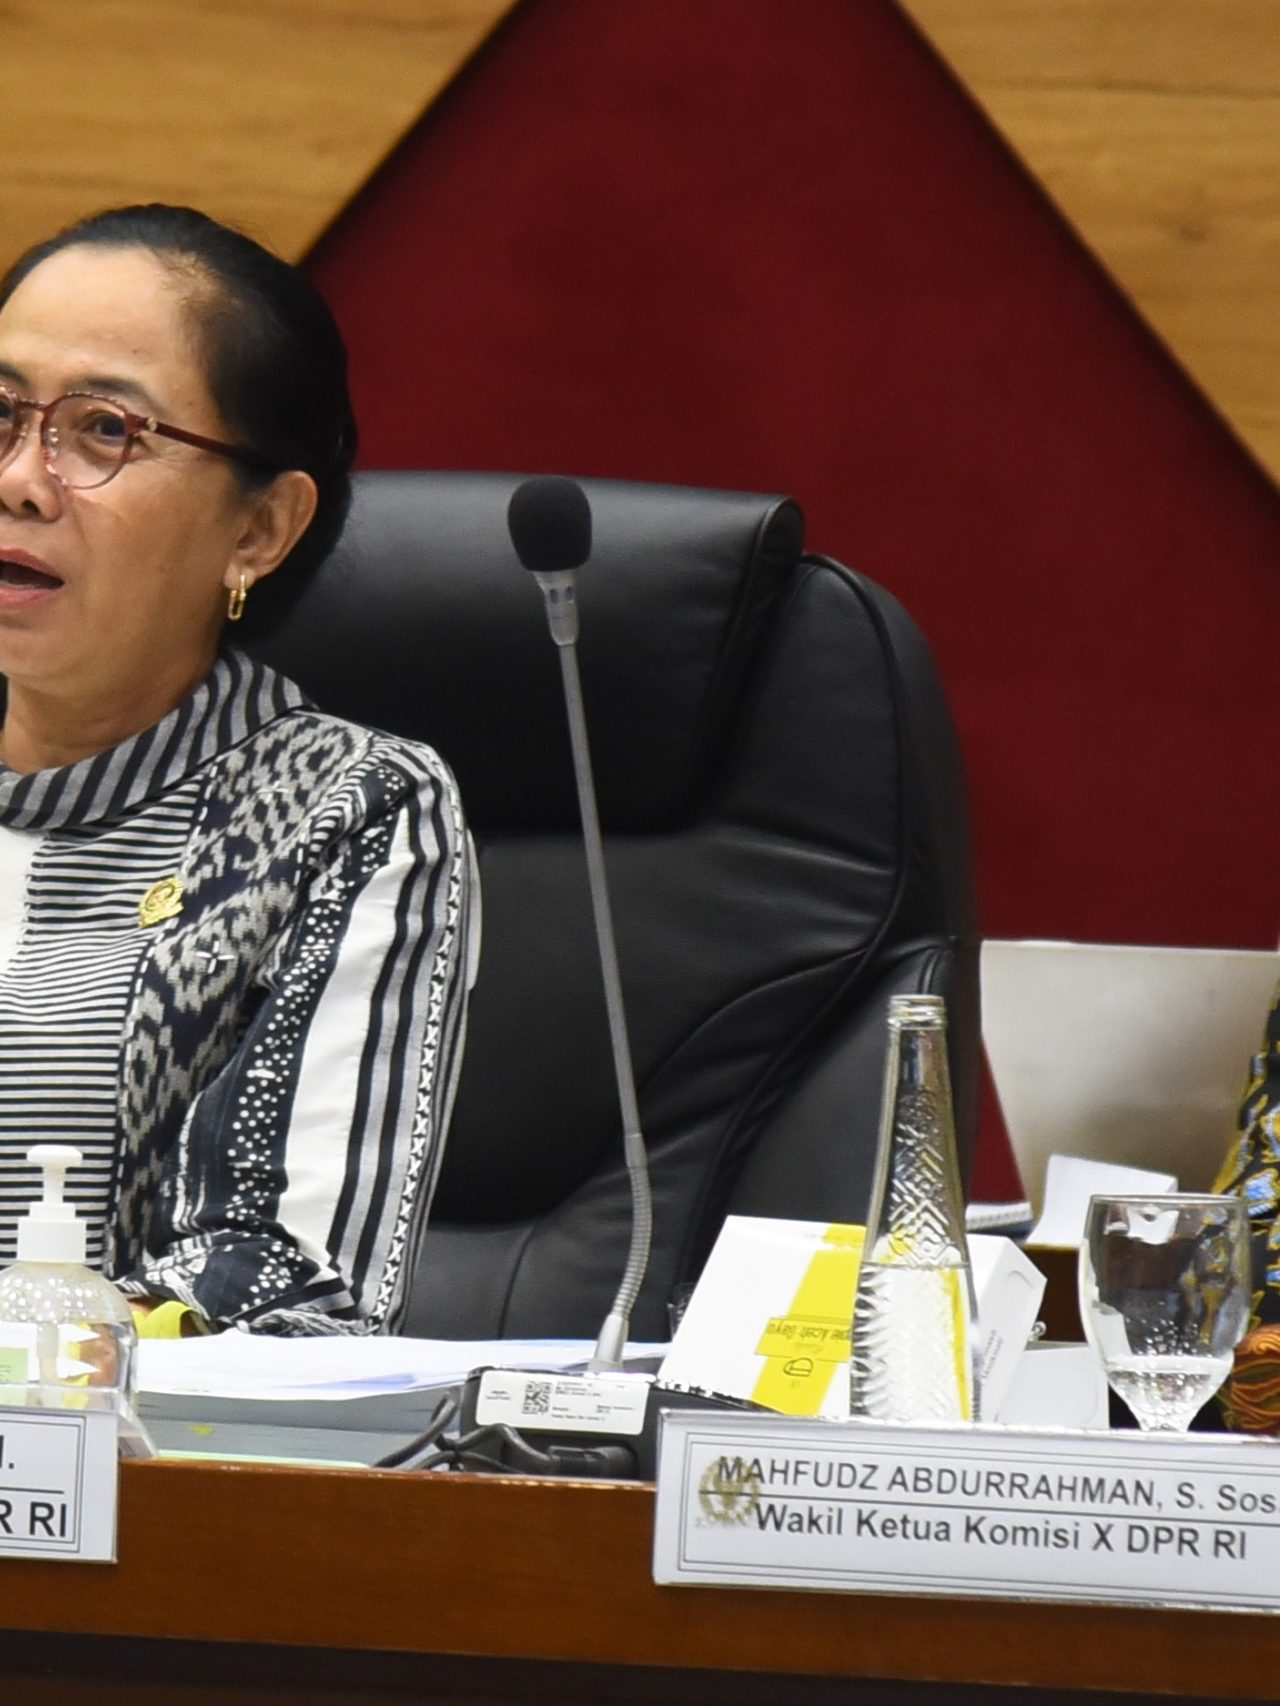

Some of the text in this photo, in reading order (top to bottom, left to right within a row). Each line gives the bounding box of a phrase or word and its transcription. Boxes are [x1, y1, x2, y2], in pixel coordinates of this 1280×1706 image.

[719, 1455, 880, 1492] MAHFUDZ
[886, 1465, 1164, 1513] ABDURRAHMAN,
[1175, 1481, 1206, 1510] S.
[28, 1500, 68, 1538] RI
[755, 1502, 1248, 1561] Wakil Ketua Komisi X DPR RI
